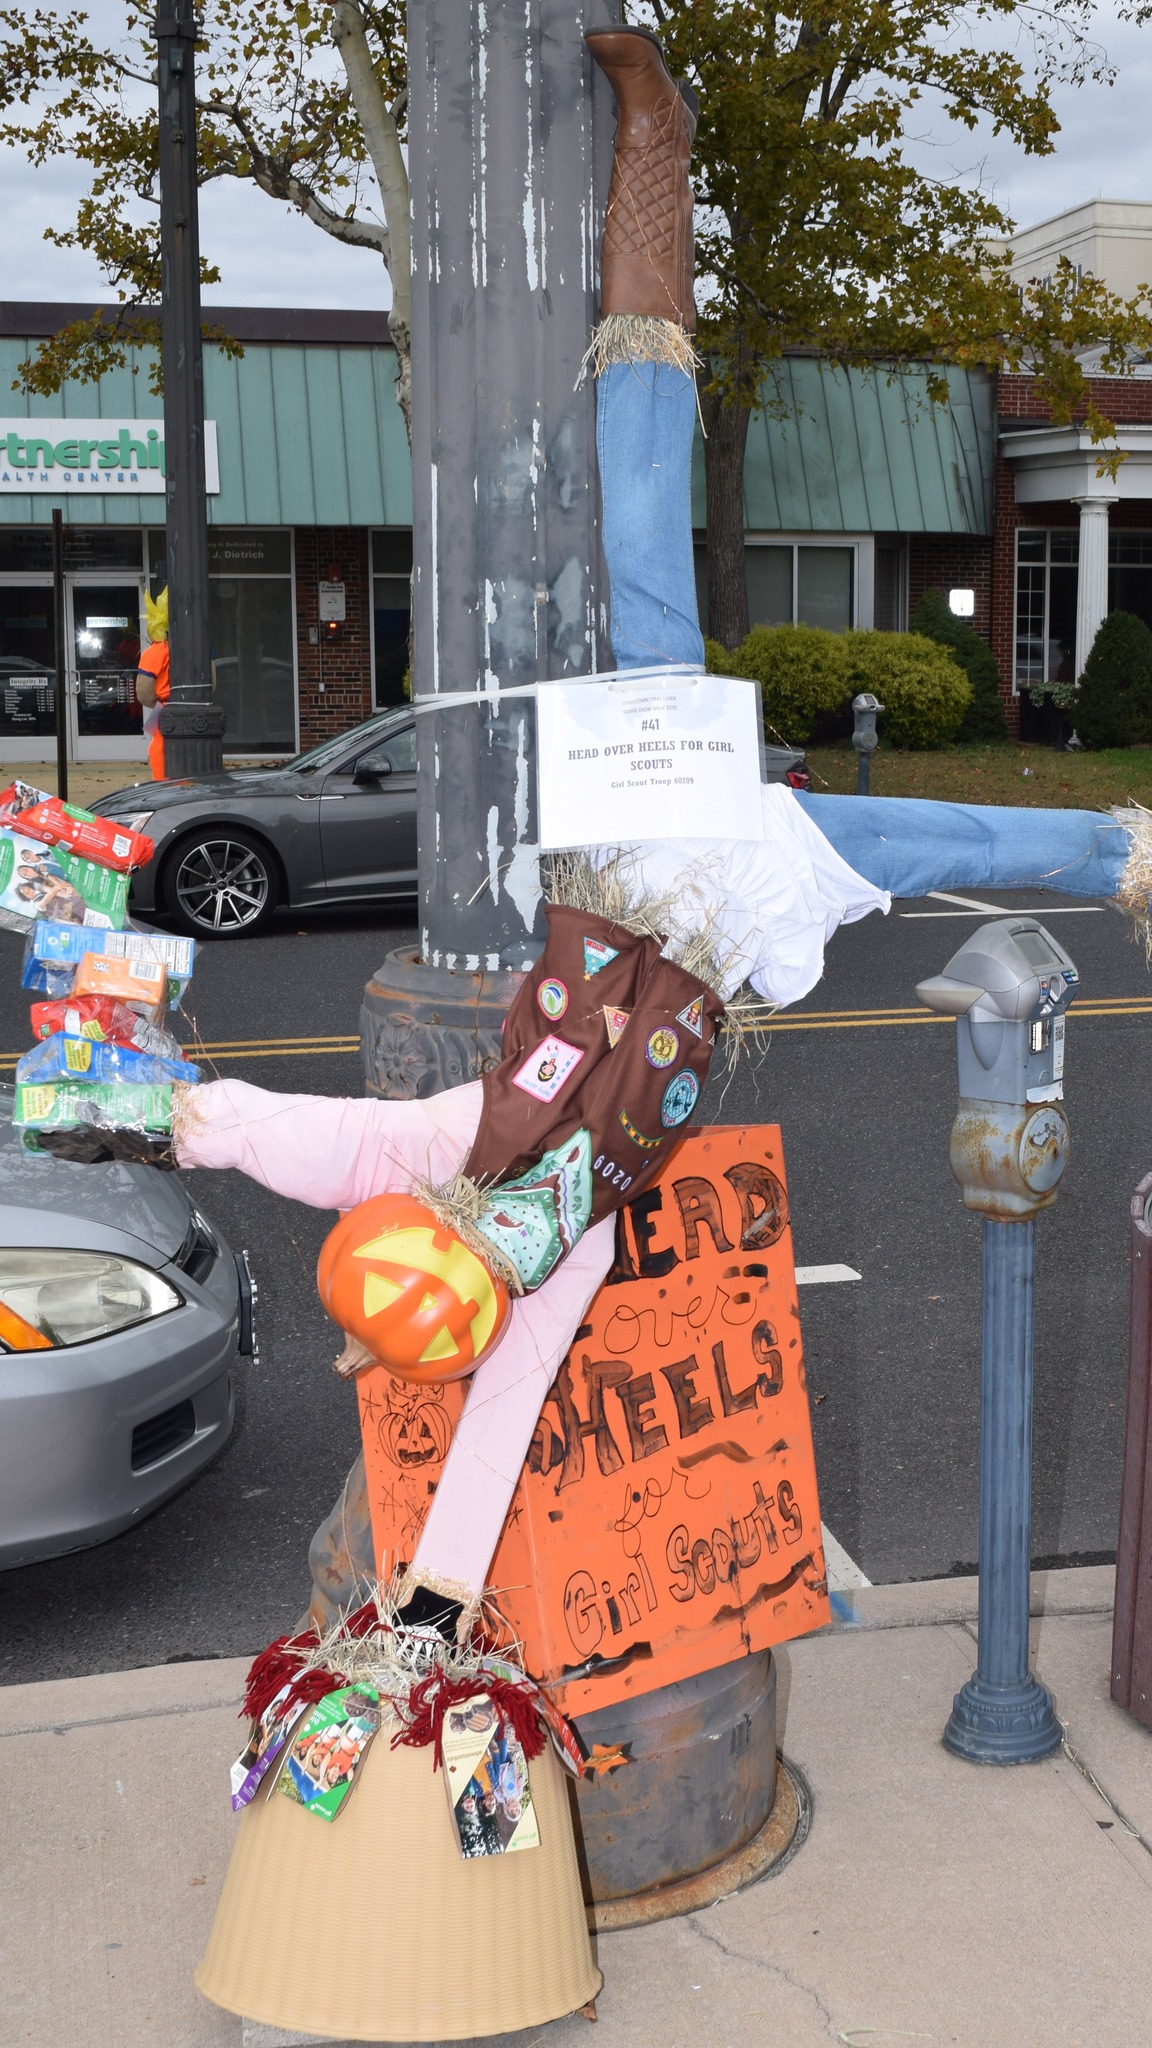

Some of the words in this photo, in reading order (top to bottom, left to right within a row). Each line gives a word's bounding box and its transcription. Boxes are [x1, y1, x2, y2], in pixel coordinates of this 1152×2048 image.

[64, 472, 138, 482] CENTER
[212, 551, 221, 559] J.
[224, 550, 264, 559] Dietrich
[87, 617, 127, 625] partnership
[641, 718, 659, 731] #41
[568, 748, 599, 760] HEAD
[604, 743, 634, 757] OVER
[638, 740, 676, 752] HEELS
[680, 740, 703, 751] FOR
[707, 741, 735, 753] GIRL
[630, 758, 673, 771] SCOUTS
[611, 780, 625, 788] Girl
[627, 779, 647, 787] Scout
[650, 778, 672, 786] Troop
[547, 1320, 784, 1495] HEELS
[614, 1465, 711, 1558] for
[562, 1551, 659, 1657] Girl
[665, 1479, 804, 1604] Scouts
